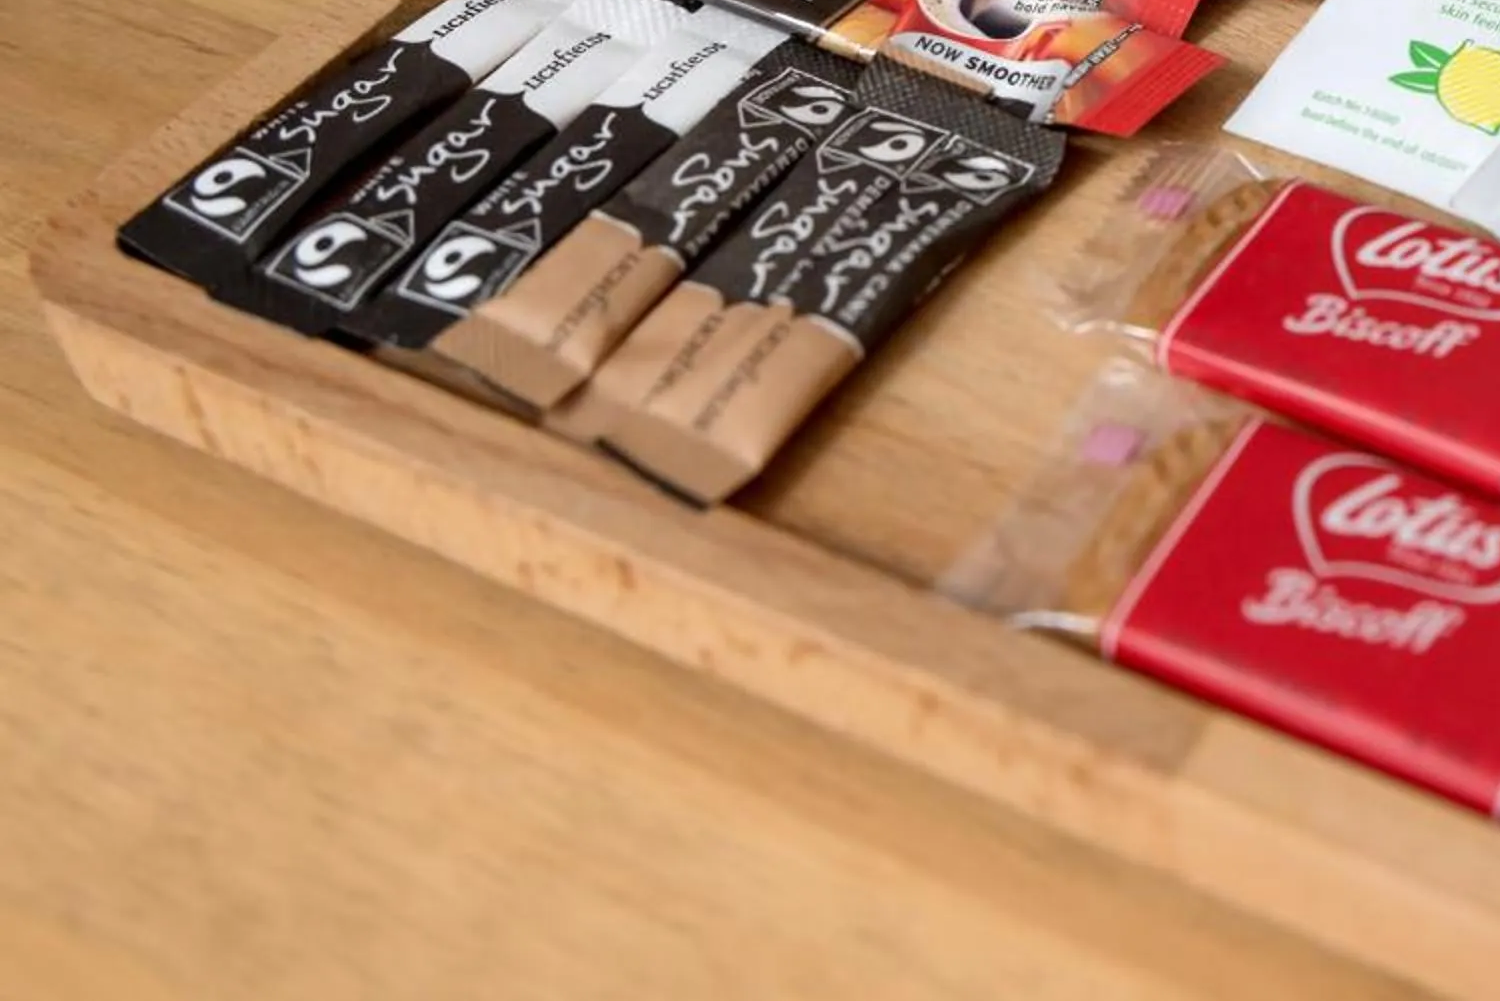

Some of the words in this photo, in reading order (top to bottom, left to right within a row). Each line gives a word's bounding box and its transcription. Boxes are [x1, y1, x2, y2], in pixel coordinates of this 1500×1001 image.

[914, 35, 965, 62] NOW
[964, 55, 1058, 91] SMOOTHER
[1283, 292, 1481, 358] Biscoff
[1241, 567, 1467, 654] Biscoff
